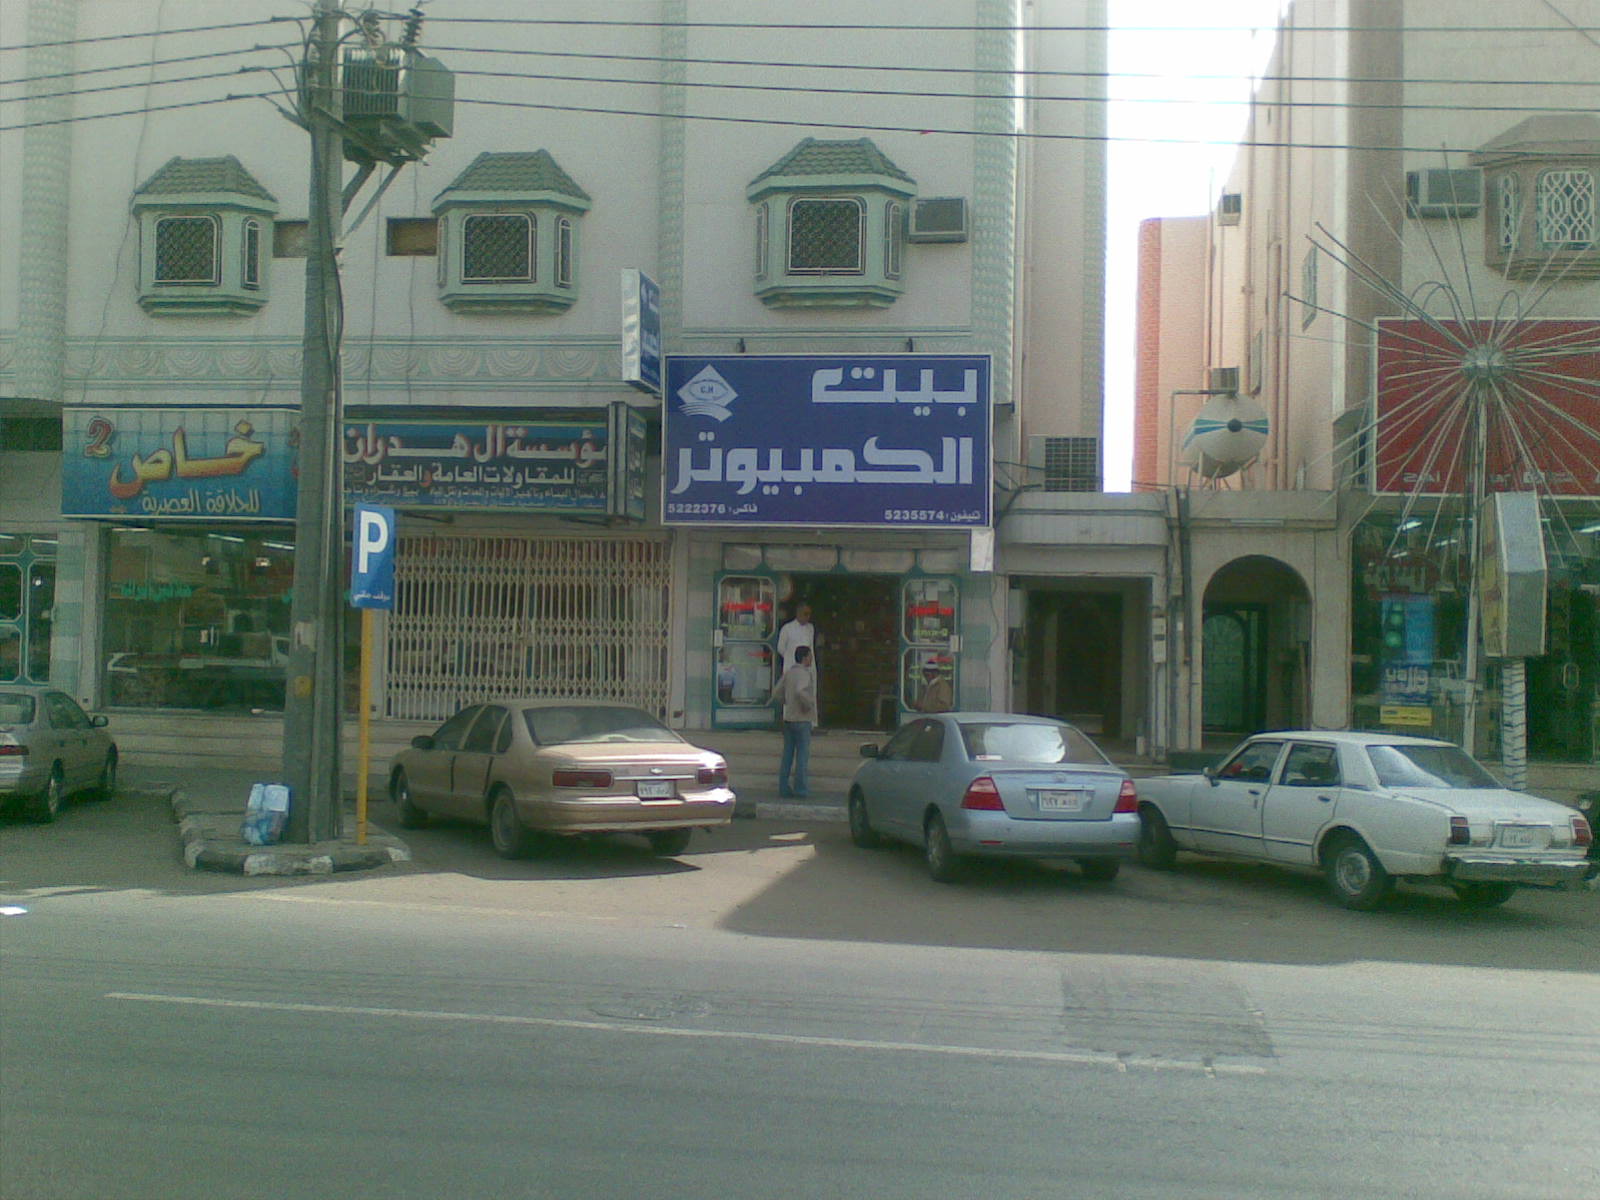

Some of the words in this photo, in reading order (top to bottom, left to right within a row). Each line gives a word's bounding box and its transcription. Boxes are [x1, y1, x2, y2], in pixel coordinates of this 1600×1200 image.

[811, 366, 978, 417] بيت
[84, 416, 113, 458] 2
[110, 419, 265, 499] خاص
[432, 462, 482, 483] العامة
[484, 465, 575, 489] للمقاولات
[670, 431, 973, 496] الكمبيوتر
[884, 509, 945, 521] 5235574
[358, 510, 389, 574] P
